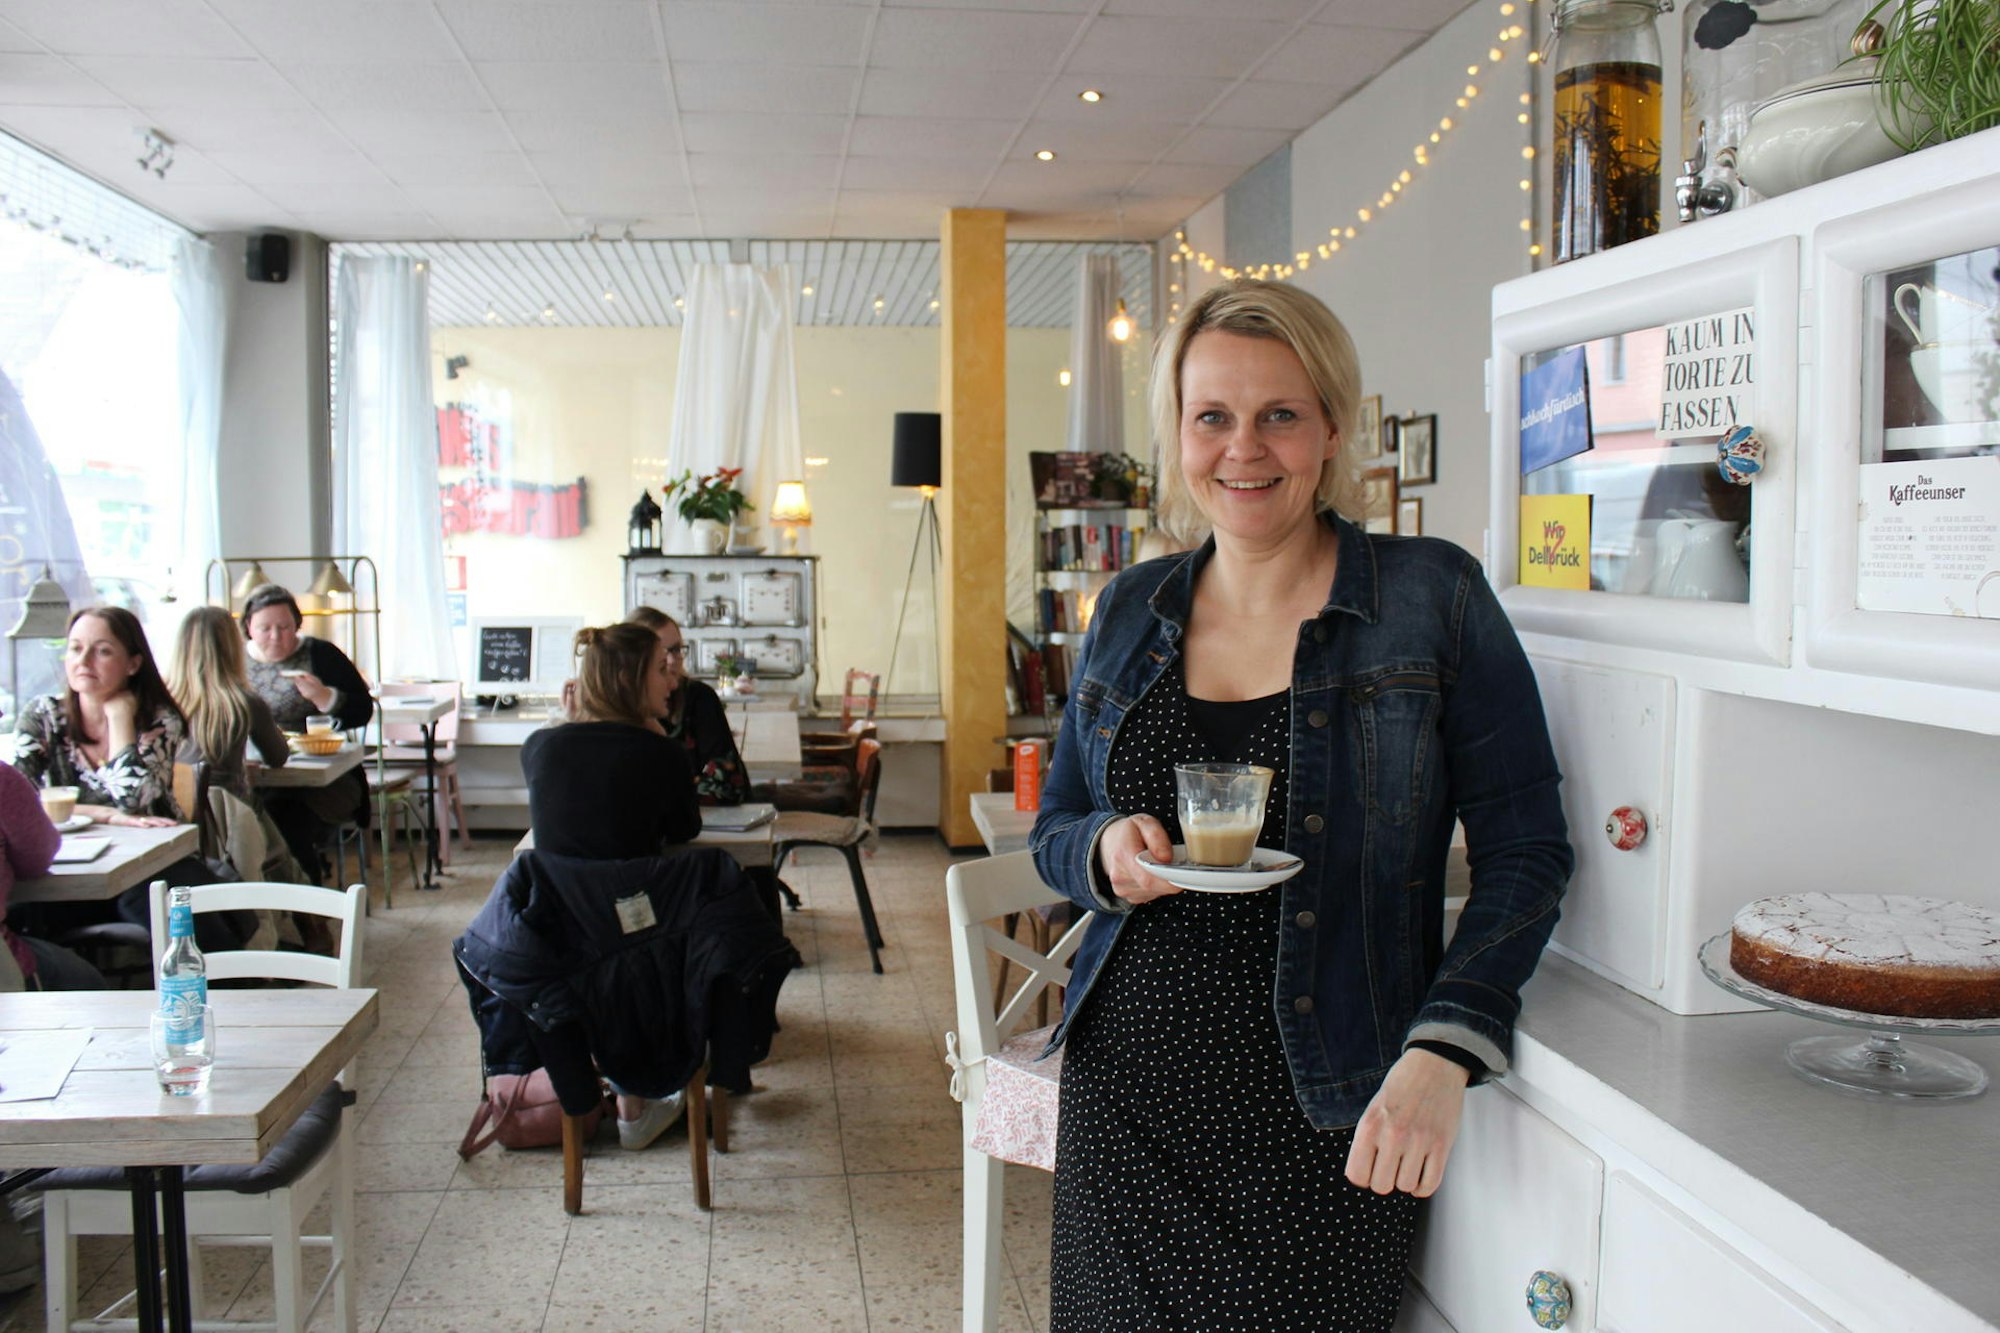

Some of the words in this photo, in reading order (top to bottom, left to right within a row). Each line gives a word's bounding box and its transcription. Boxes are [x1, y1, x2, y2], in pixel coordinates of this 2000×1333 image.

[1665, 318, 1723, 356] KAUM
[1734, 312, 1754, 345] IN
[1665, 357, 1726, 391] TORTE
[1660, 395, 1741, 431] FASSEN
[1918, 475, 1932, 485] Das
[1889, 485, 1966, 506] Kaffeeunser
[1529, 546, 1580, 567] Dellbrück
